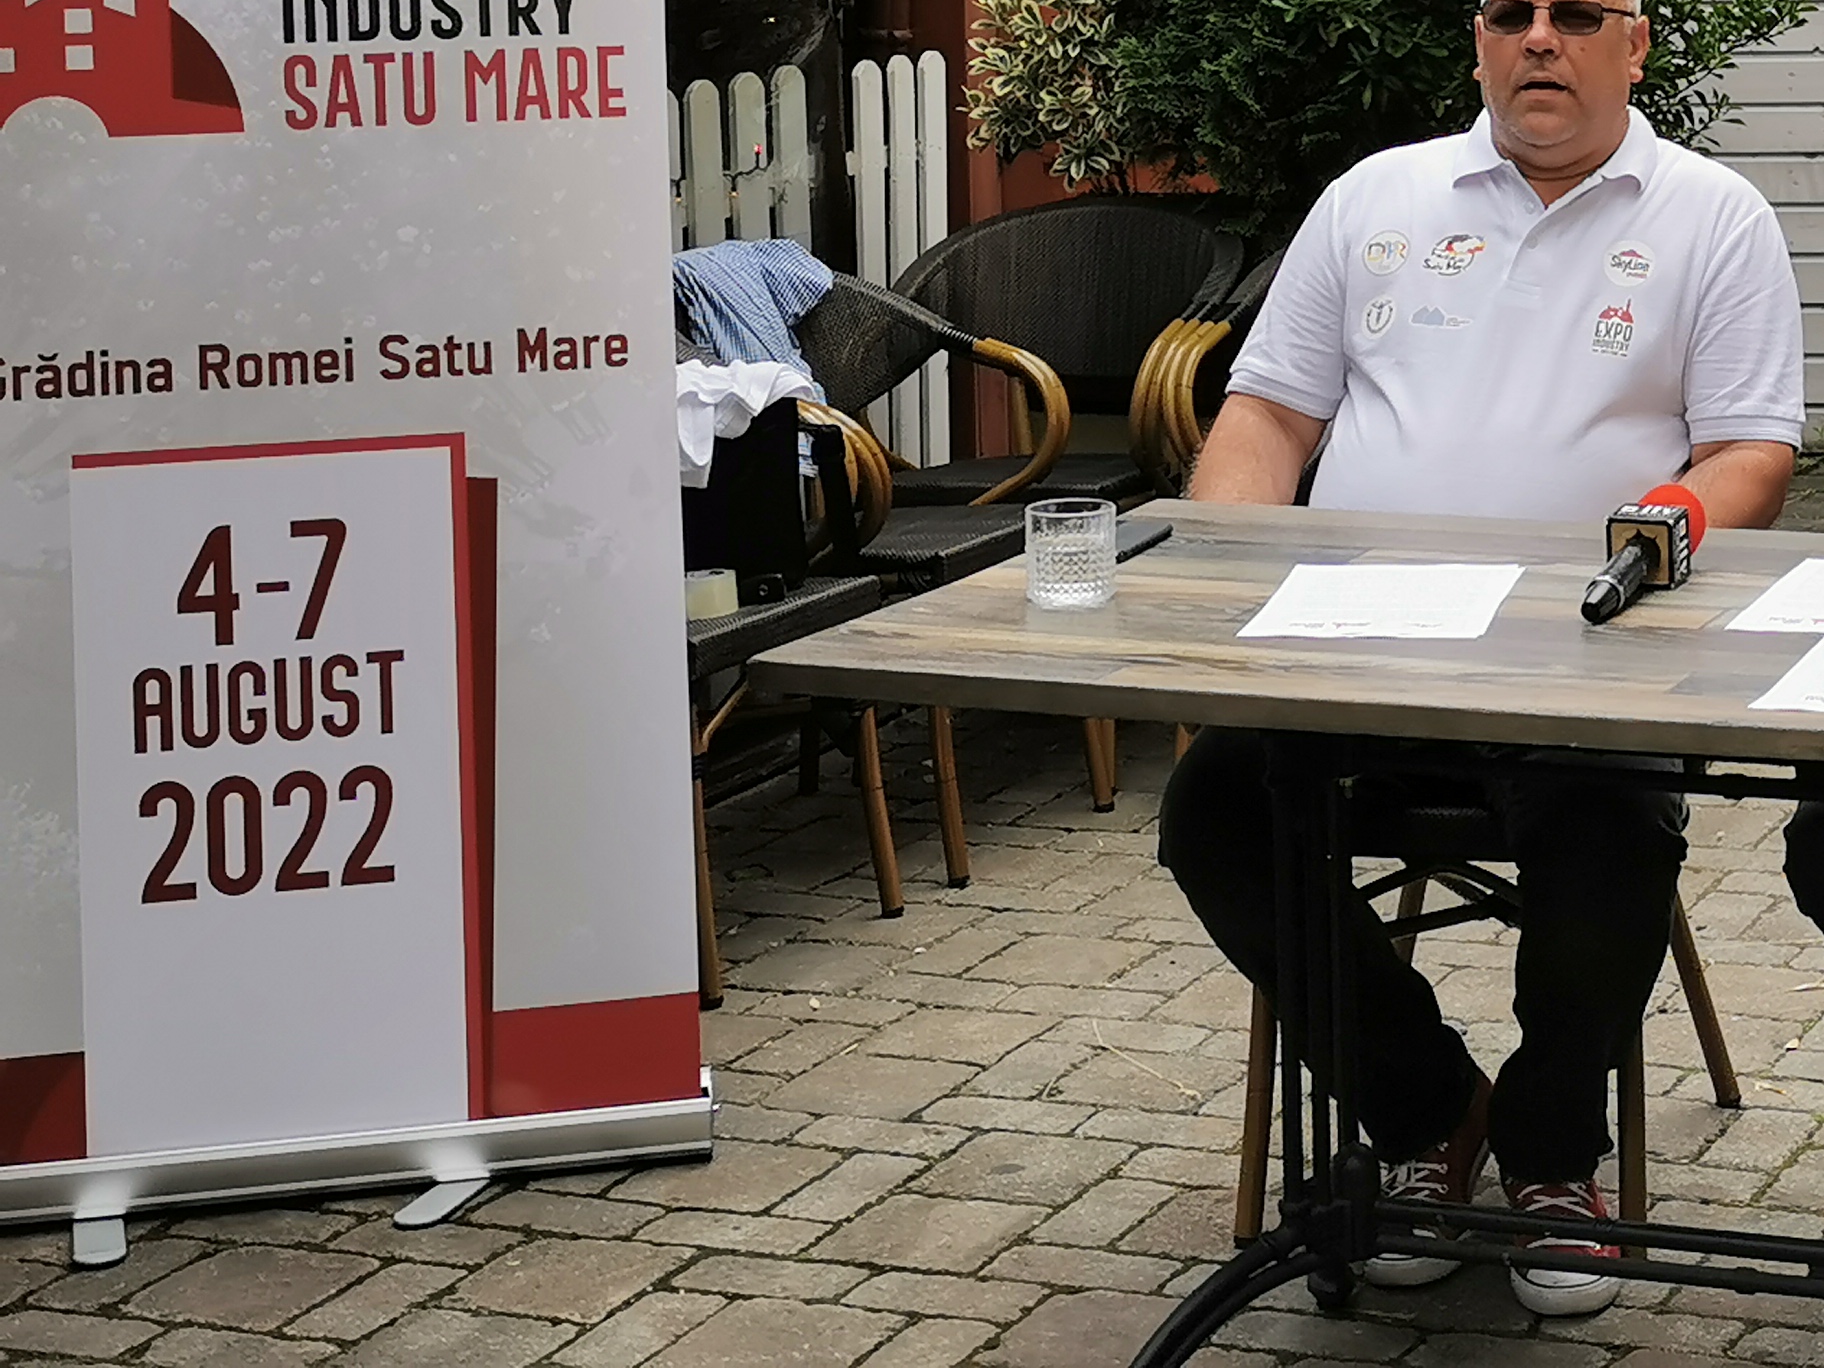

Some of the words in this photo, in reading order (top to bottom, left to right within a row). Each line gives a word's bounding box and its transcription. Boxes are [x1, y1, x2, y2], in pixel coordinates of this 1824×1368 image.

[283, 50, 437, 131] SATU
[463, 45, 627, 123] MARE
[0, 349, 174, 402] rădina
[198, 336, 354, 391] Romei
[378, 334, 493, 381] Satu
[516, 327, 629, 374] Mare
[1594, 319, 1634, 343] EXPO
[176, 518, 348, 646] 4-7
[132, 649, 405, 754] AUGUST
[138, 764, 396, 905] 2022
